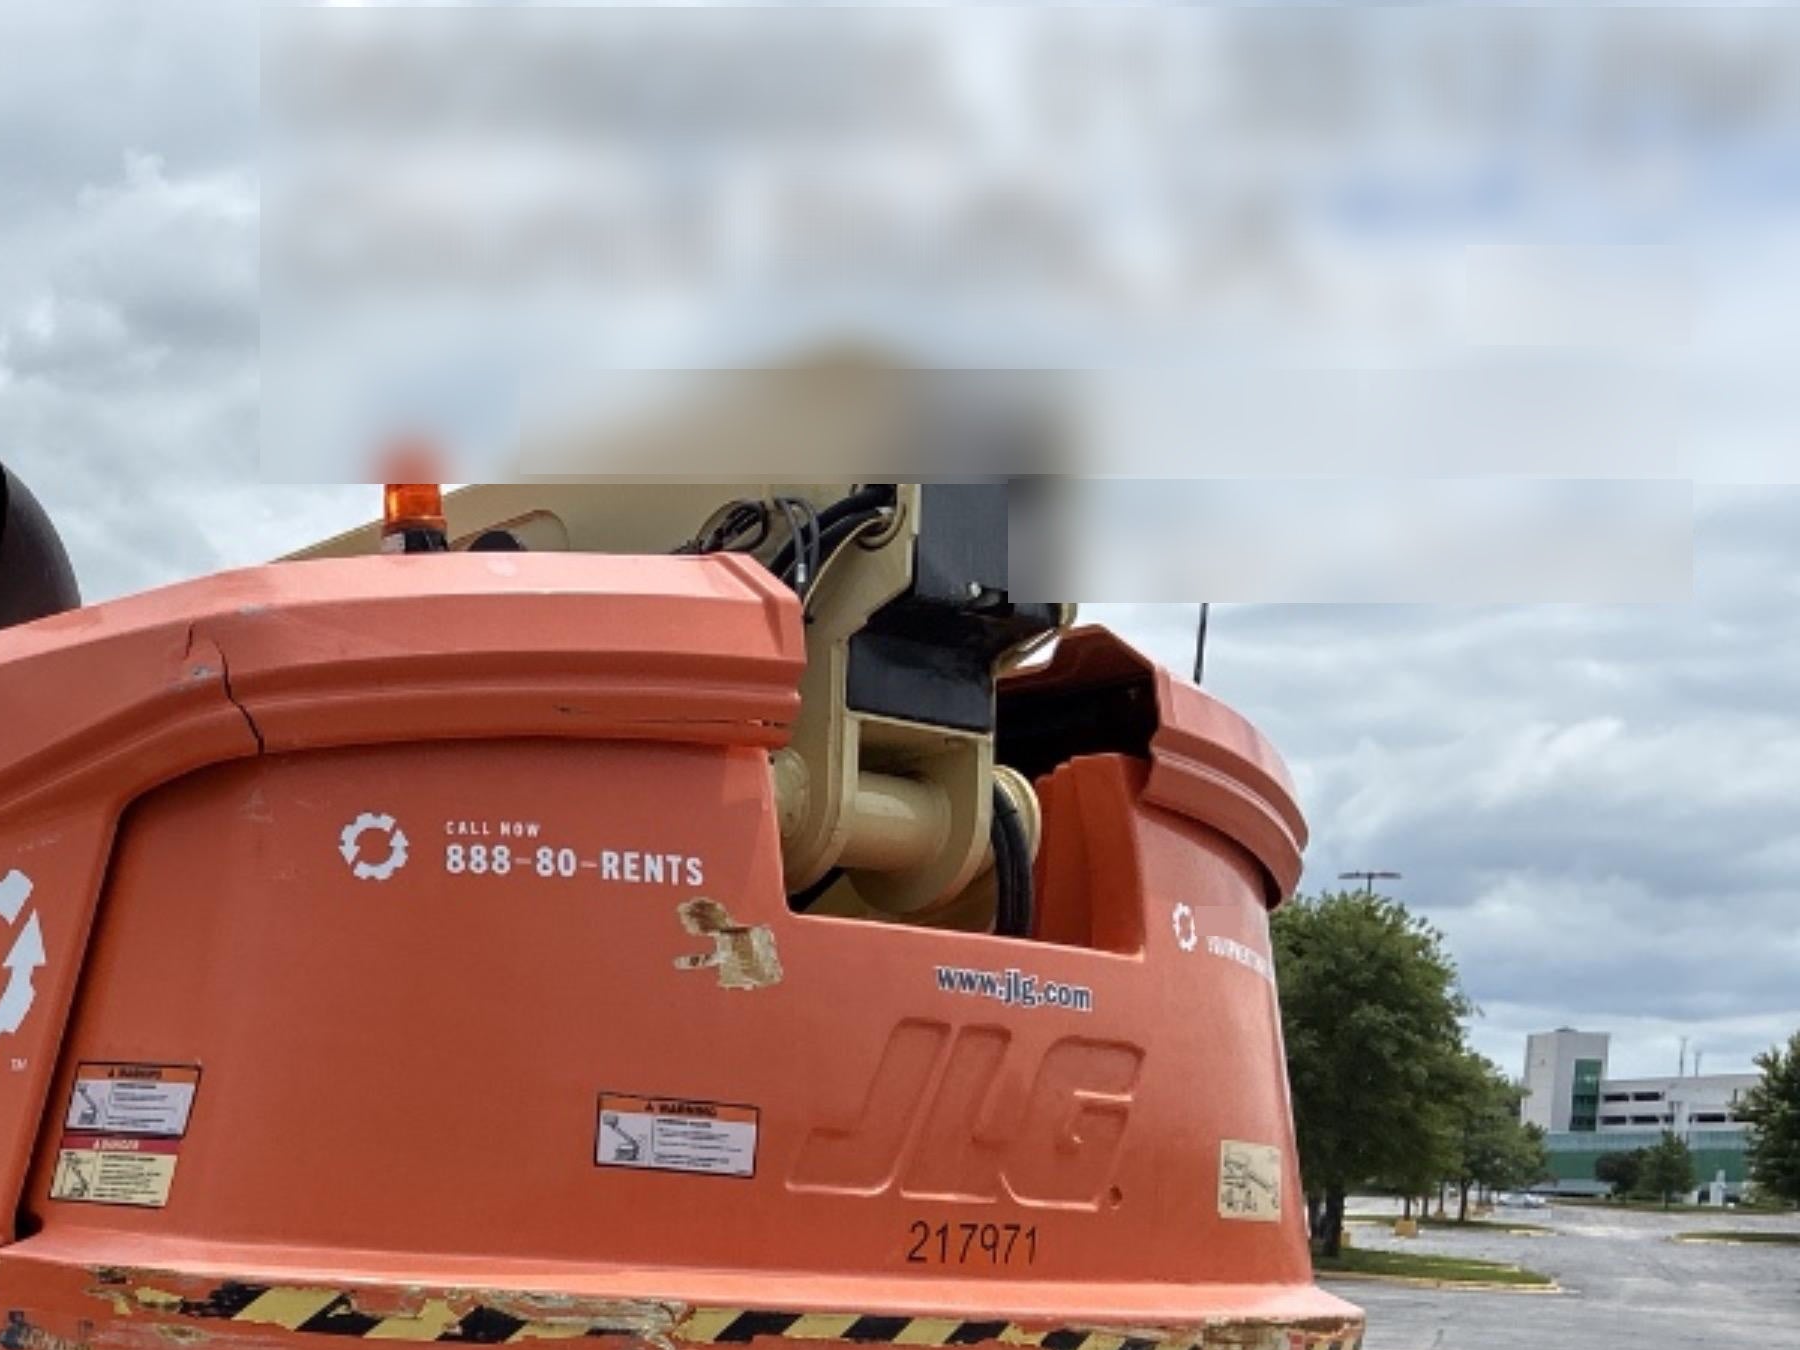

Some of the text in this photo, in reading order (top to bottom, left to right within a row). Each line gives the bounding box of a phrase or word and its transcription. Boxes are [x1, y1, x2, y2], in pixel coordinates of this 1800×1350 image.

[445, 821, 541, 837] CALL NOW
[446, 844, 703, 886] 888-80-RENTS
[935, 966, 1092, 1011] www.jlg.com
[784, 1016, 1146, 1213] JLG
[906, 1219, 1038, 1265] 217971
